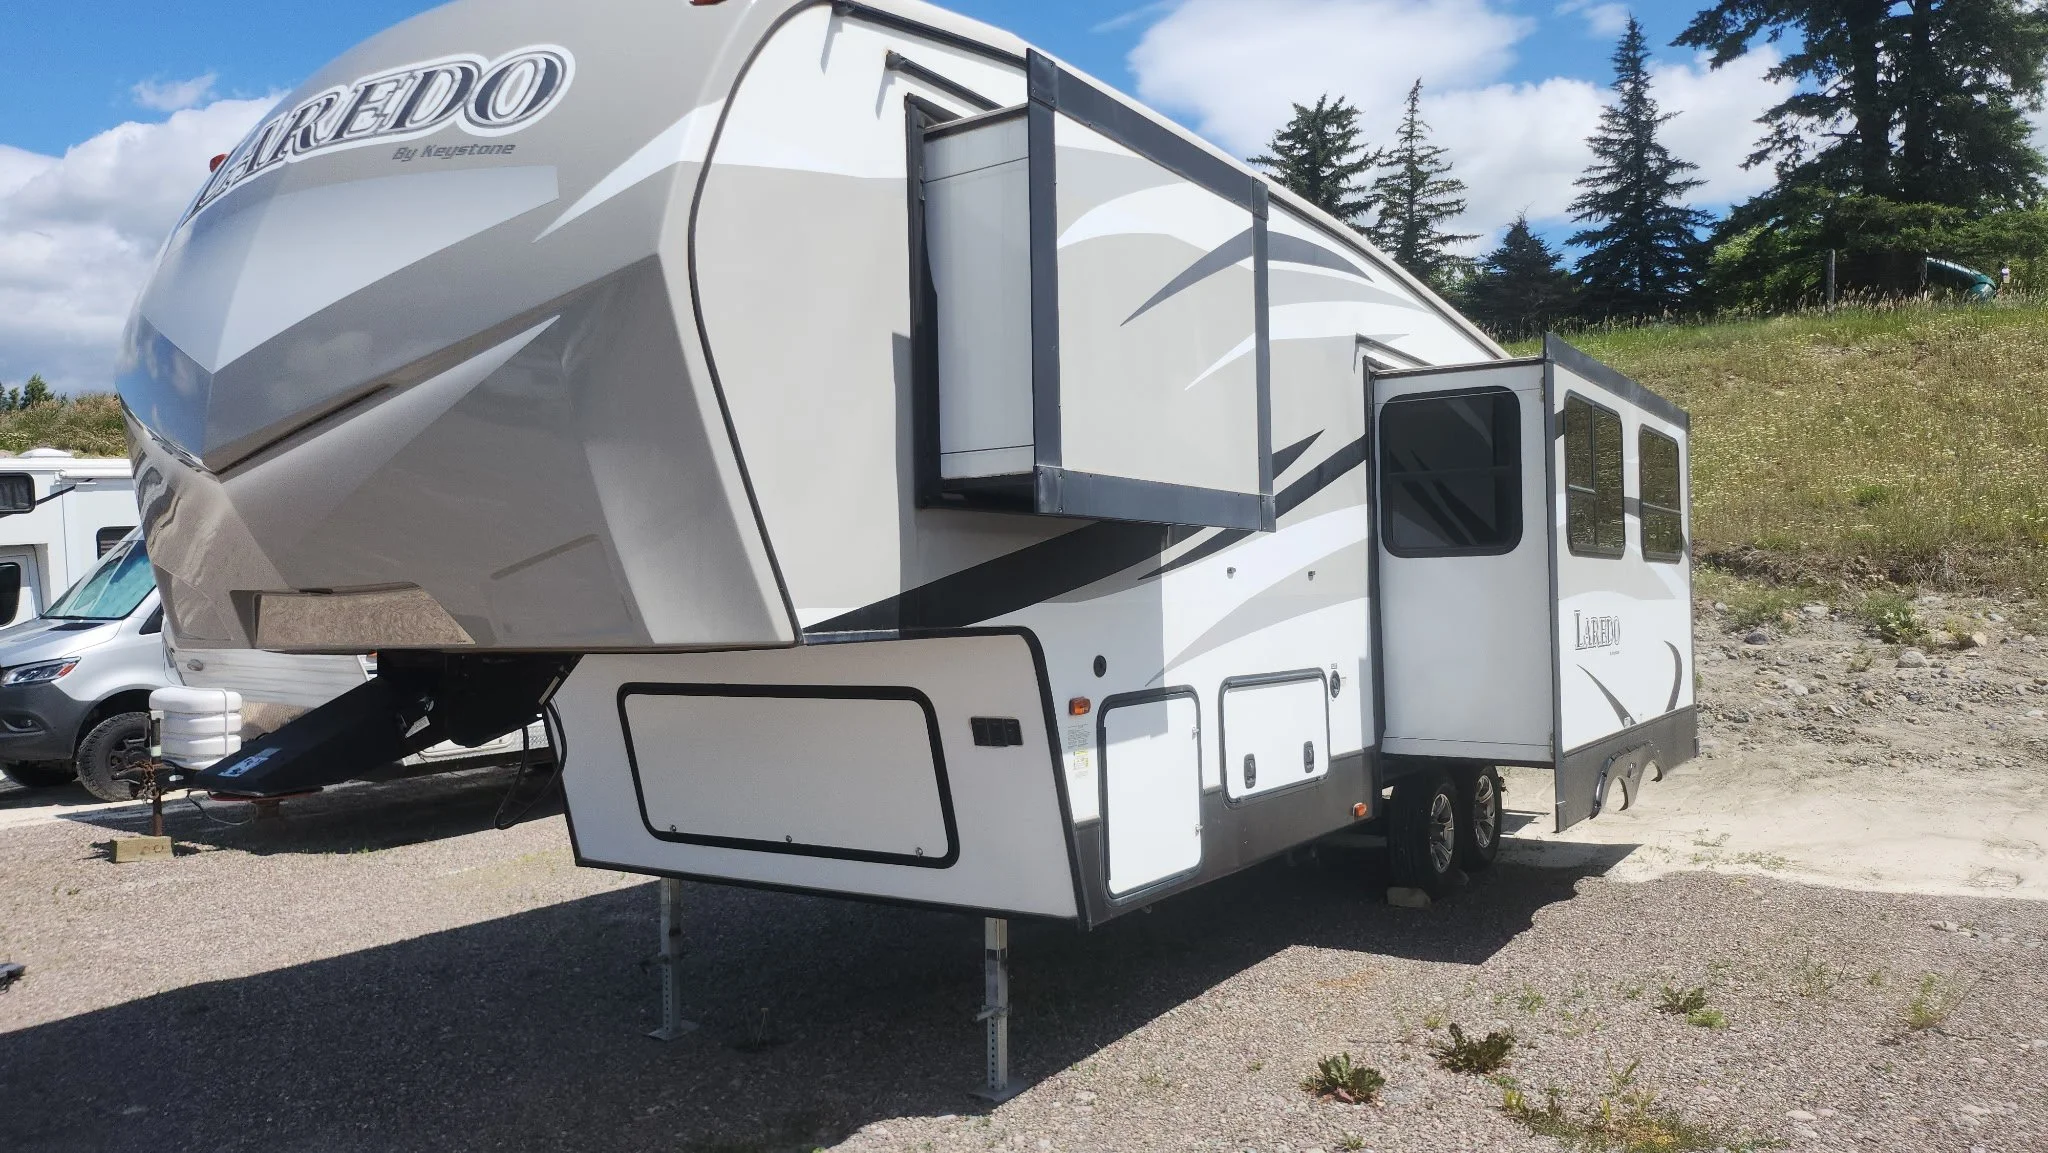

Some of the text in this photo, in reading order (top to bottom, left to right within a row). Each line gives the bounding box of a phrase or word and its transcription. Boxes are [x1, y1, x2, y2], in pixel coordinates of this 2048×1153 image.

[185, 46, 572, 224] LAREDO
[392, 144, 516, 162] By Keystone
[1573, 609, 1621, 651] LAREDO
